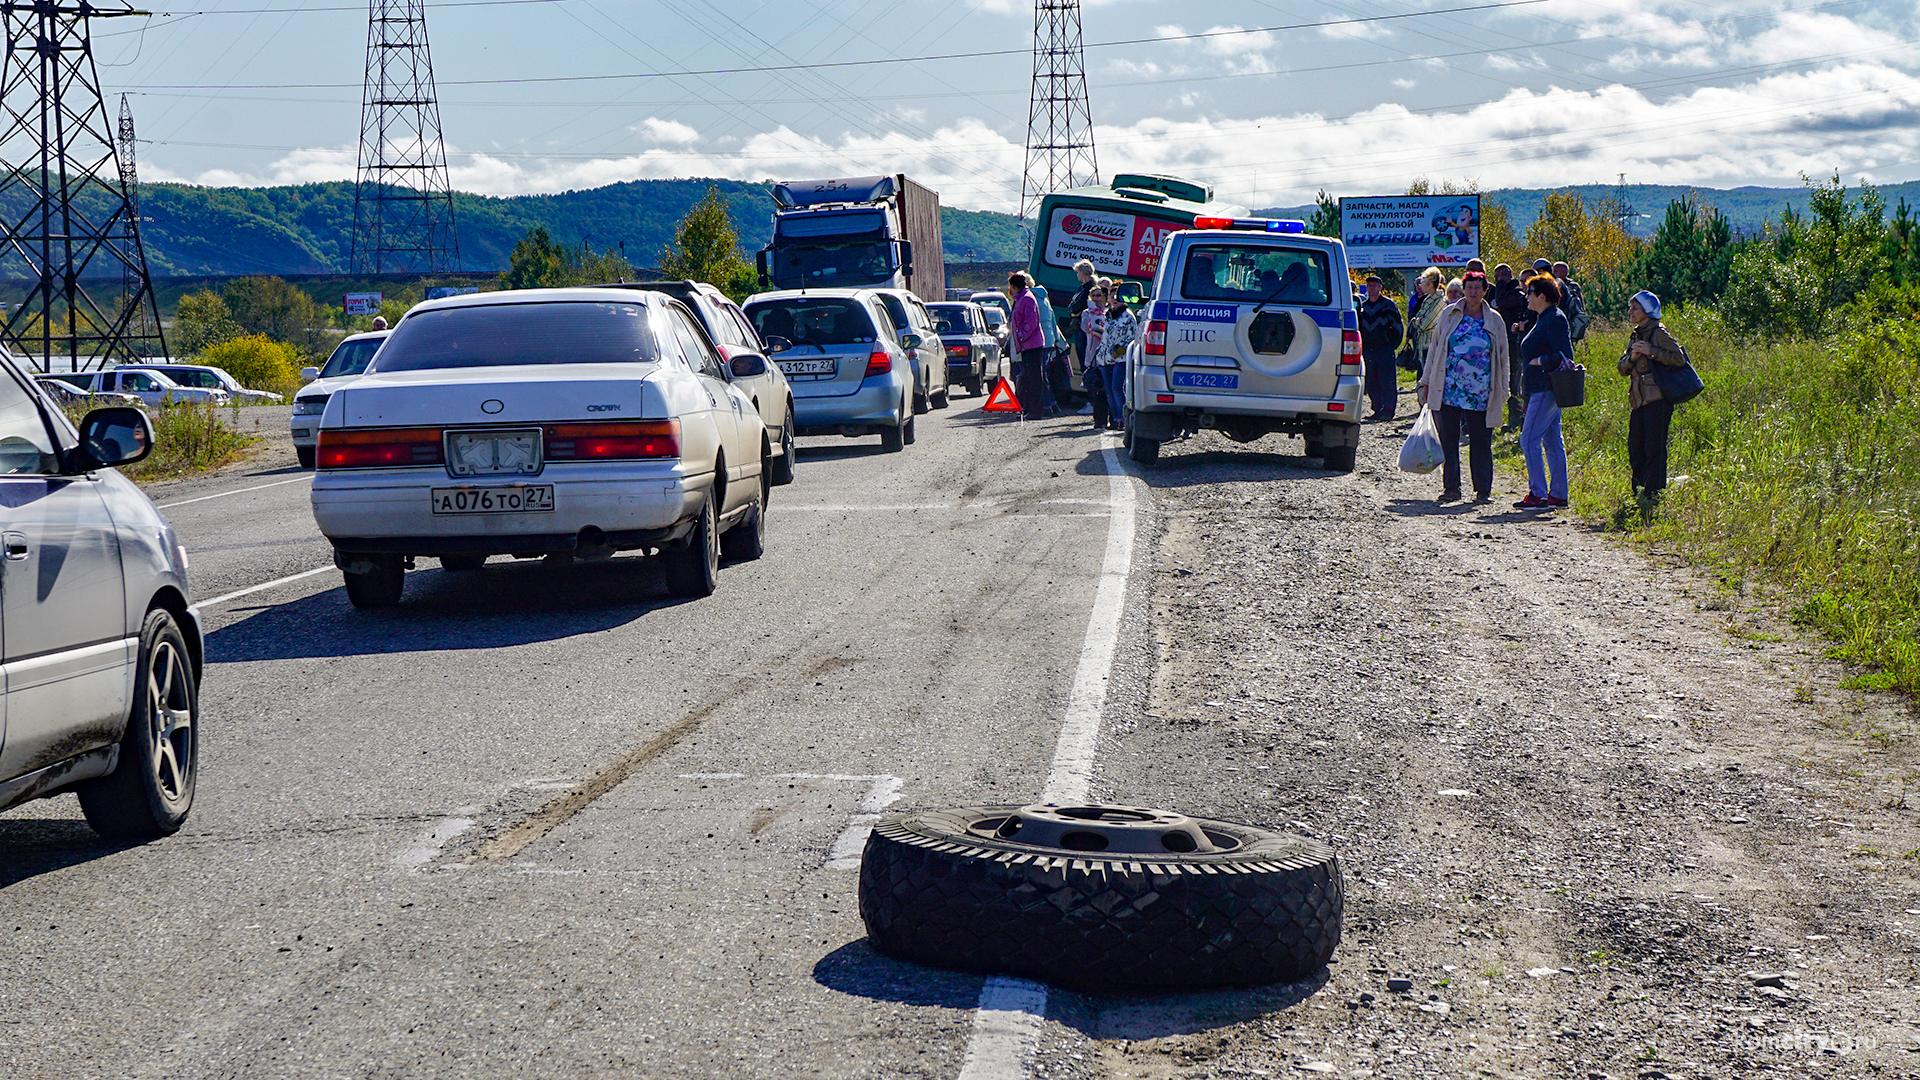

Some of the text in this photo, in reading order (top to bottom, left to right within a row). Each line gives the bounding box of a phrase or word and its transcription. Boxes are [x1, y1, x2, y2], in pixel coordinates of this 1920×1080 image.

[814, 183, 849, 193] 254
[1346, 202, 1430, 211] ЗАПЧАСТИ, МАСЛА
[1350, 211, 1425, 220] АККУМУЛЯТОРЫ
[1062, 216, 1126, 237] Японка
[1364, 220, 1414, 229] НА ЛЮБОЙ
[1351, 233, 1425, 244] HYBRID
[1058, 241, 1115, 256] Партизанская,
[1055, 250, 1061, 258] 8
[1063, 251, 1078, 260] 914
[1175, 308, 1231, 318] ПОЛИЦИЯ
[1177, 329, 1216, 343] ДПС
[1190, 375, 1217, 386] 1242
[1223, 376, 1235, 384] 27
[526, 488, 545, 503] 27
